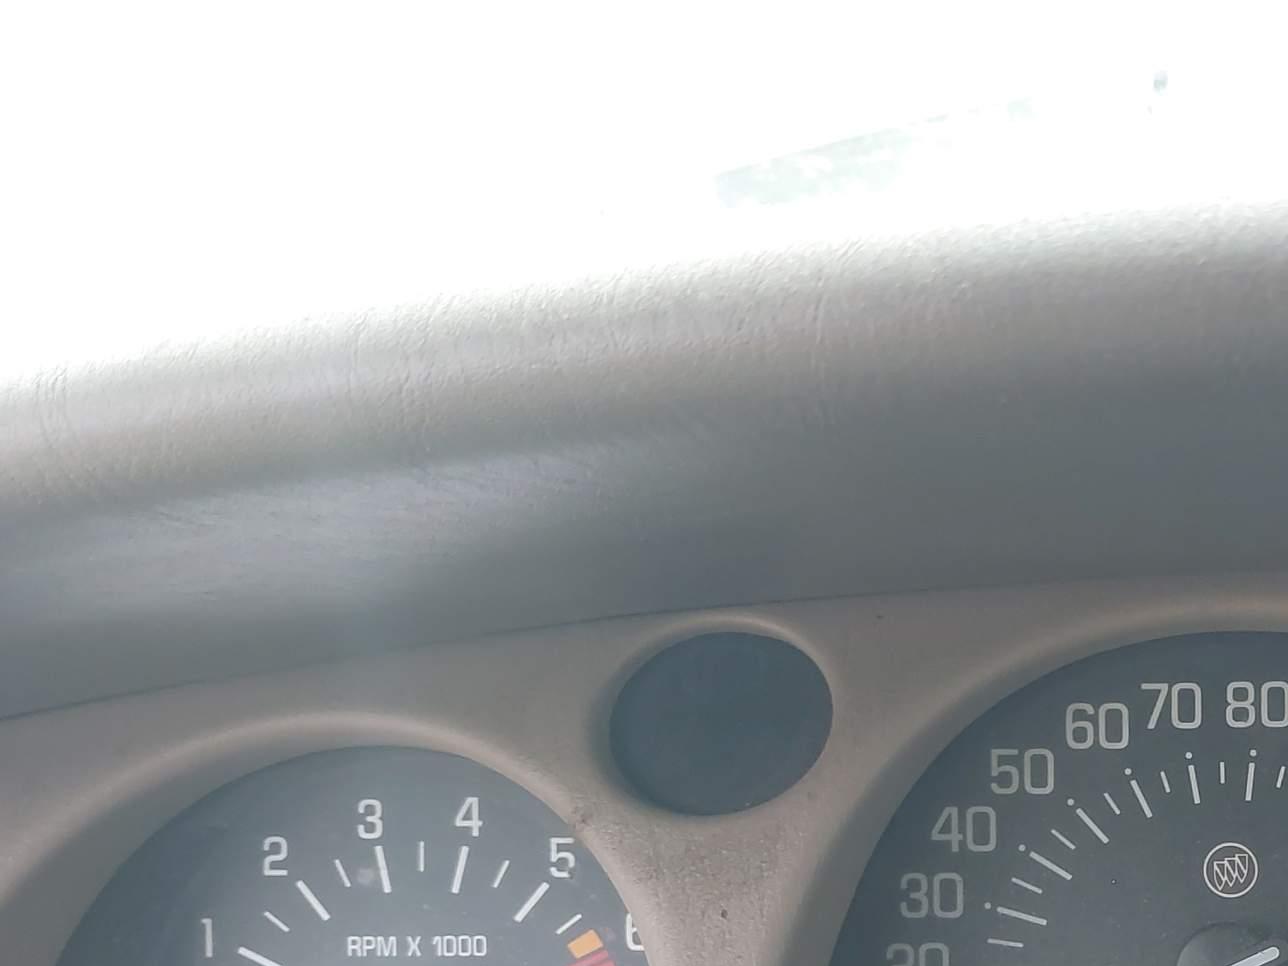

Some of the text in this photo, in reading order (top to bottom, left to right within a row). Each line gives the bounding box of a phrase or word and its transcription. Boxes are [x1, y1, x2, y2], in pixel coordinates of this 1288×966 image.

[1065, 702, 1130, 750] 60
[1141, 682, 1202, 729] 70
[990, 748, 1055, 795] 50
[356, 799, 384, 839] 3
[455, 797, 484, 837] 4
[931, 805, 997, 852] 40
[263, 836, 289, 876] 2
[550, 837, 576, 879] 5
[900, 873, 964, 919] 30
[201, 918, 214, 958] 1
[347, 935, 488, 957] RPM X 1000
